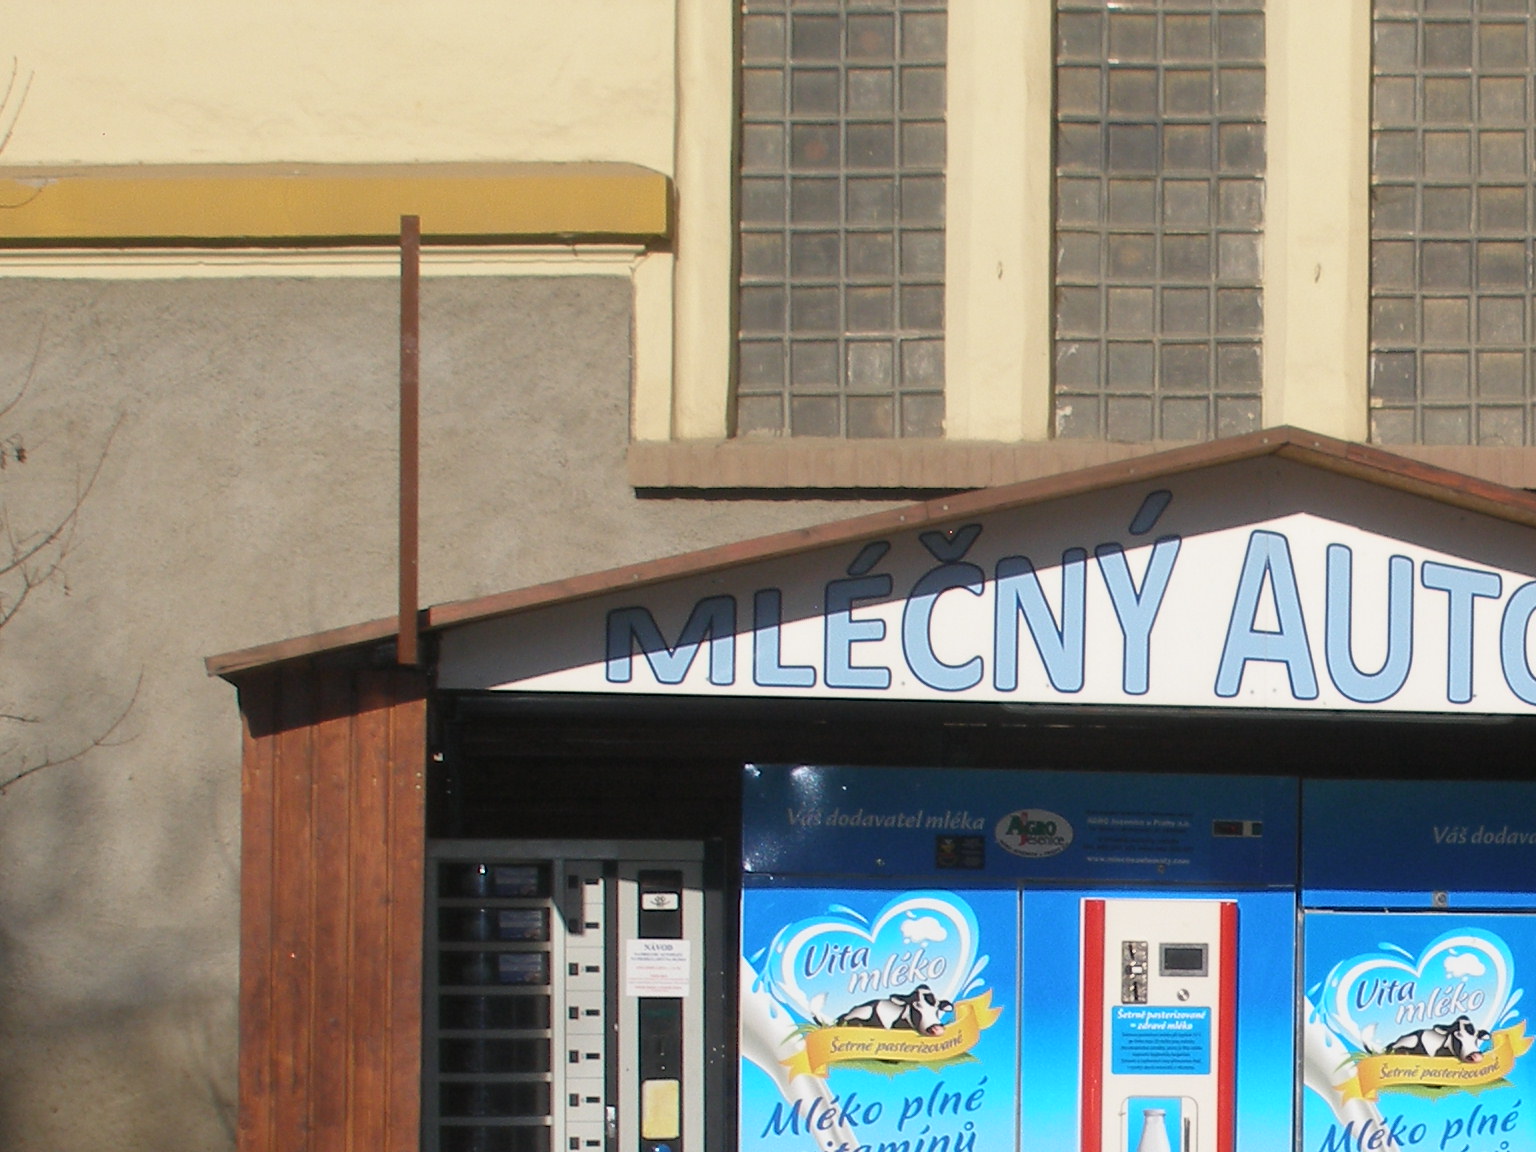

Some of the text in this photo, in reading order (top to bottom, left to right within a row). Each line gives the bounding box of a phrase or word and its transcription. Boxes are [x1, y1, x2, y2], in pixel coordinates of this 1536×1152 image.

[604, 489, 1182, 697] MLÉČNÝ
[786, 808, 985, 830] Váš dodavatel mléka
[1433, 825, 1467, 845] Váš
[804, 943, 871, 978] Vita
[848, 949, 947, 995] mléko
[1356, 979, 1416, 1011] Vita
[1394, 980, 1485, 1025] mléko
[830, 1029, 964, 1055] Šetrně pasterizované
[1379, 1056, 1500, 1080] Šetrně pasterizované
[761, 1076, 988, 1138] Mléko plné
[1440, 1099, 1522, 1150] plné
